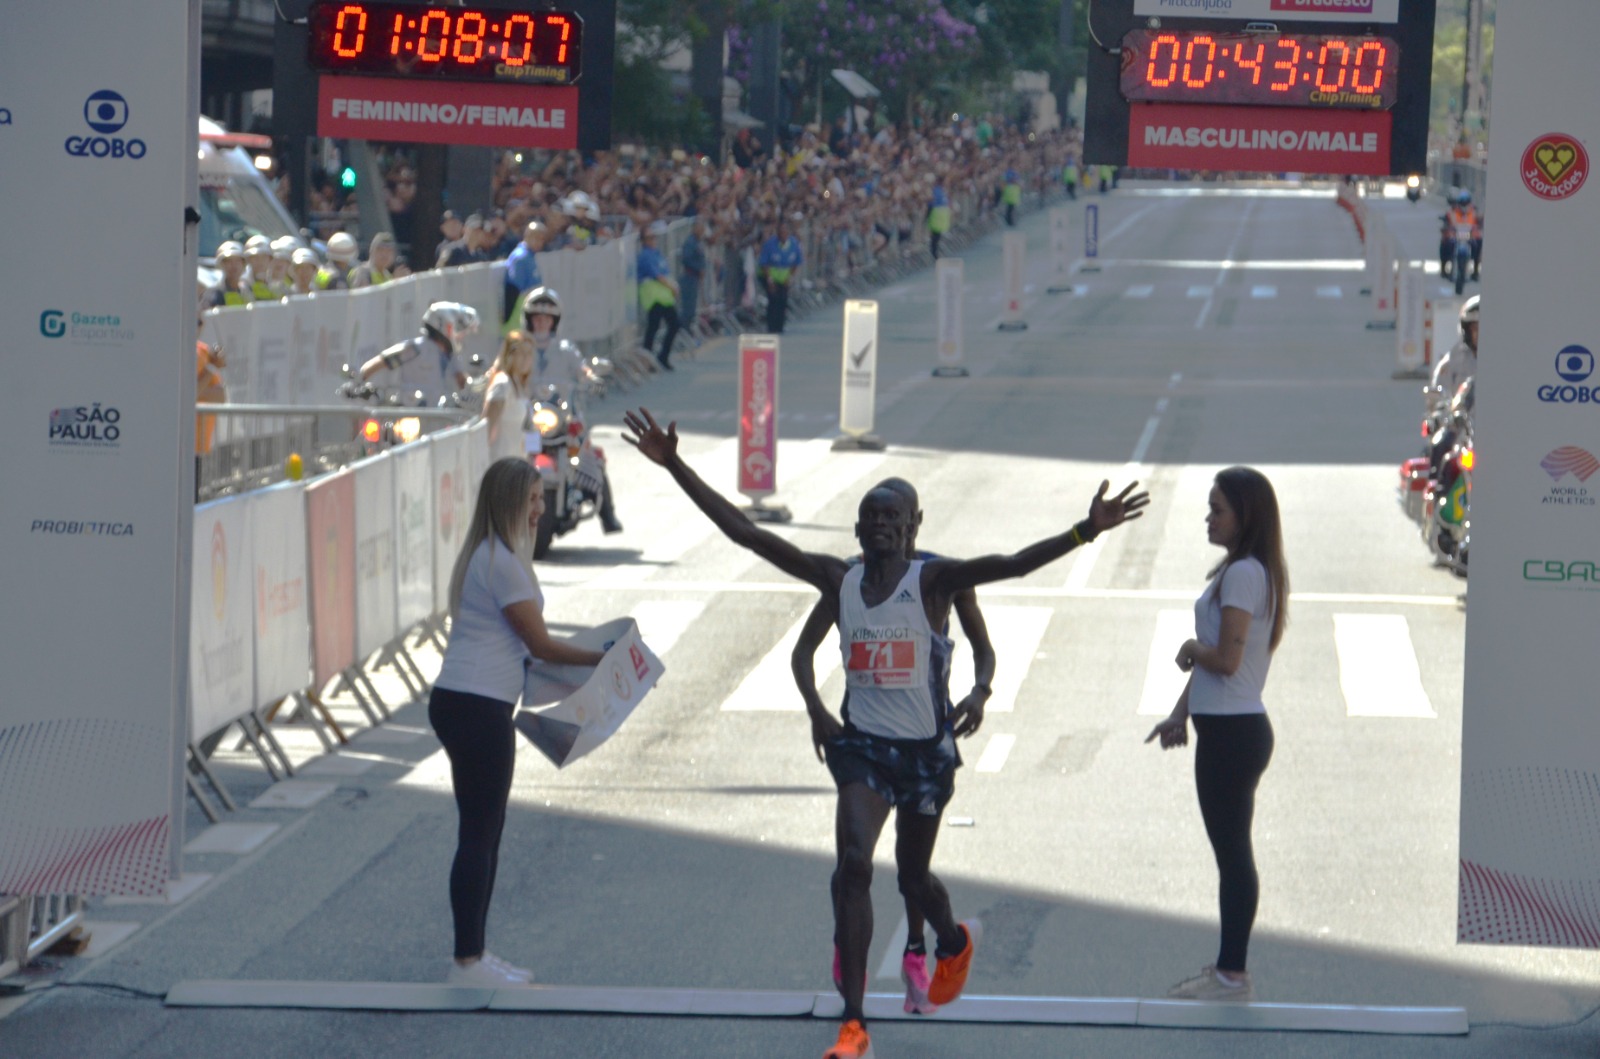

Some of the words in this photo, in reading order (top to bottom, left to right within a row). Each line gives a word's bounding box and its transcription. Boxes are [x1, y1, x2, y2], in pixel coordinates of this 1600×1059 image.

[494, 63, 567, 81] ChipTiming
[1146, 35, 1387, 93] 00:43:00
[1309, 89, 1382, 107] ChipTiming
[332, 98, 566, 129] FEMININO/FEMALE
[65, 136, 147, 159] GLOBO
[1144, 125, 1378, 153] MASCULINO/MALE
[71, 312, 121, 325] Gazeta
[71, 326, 135, 340] Esportiva
[75, 402, 121, 424] SÃO
[49, 424, 121, 441] PAULO
[1551, 487, 1587, 496] WORLD
[1541, 496, 1596, 506] ATHLETICS
[865, 642, 894, 668] 71
